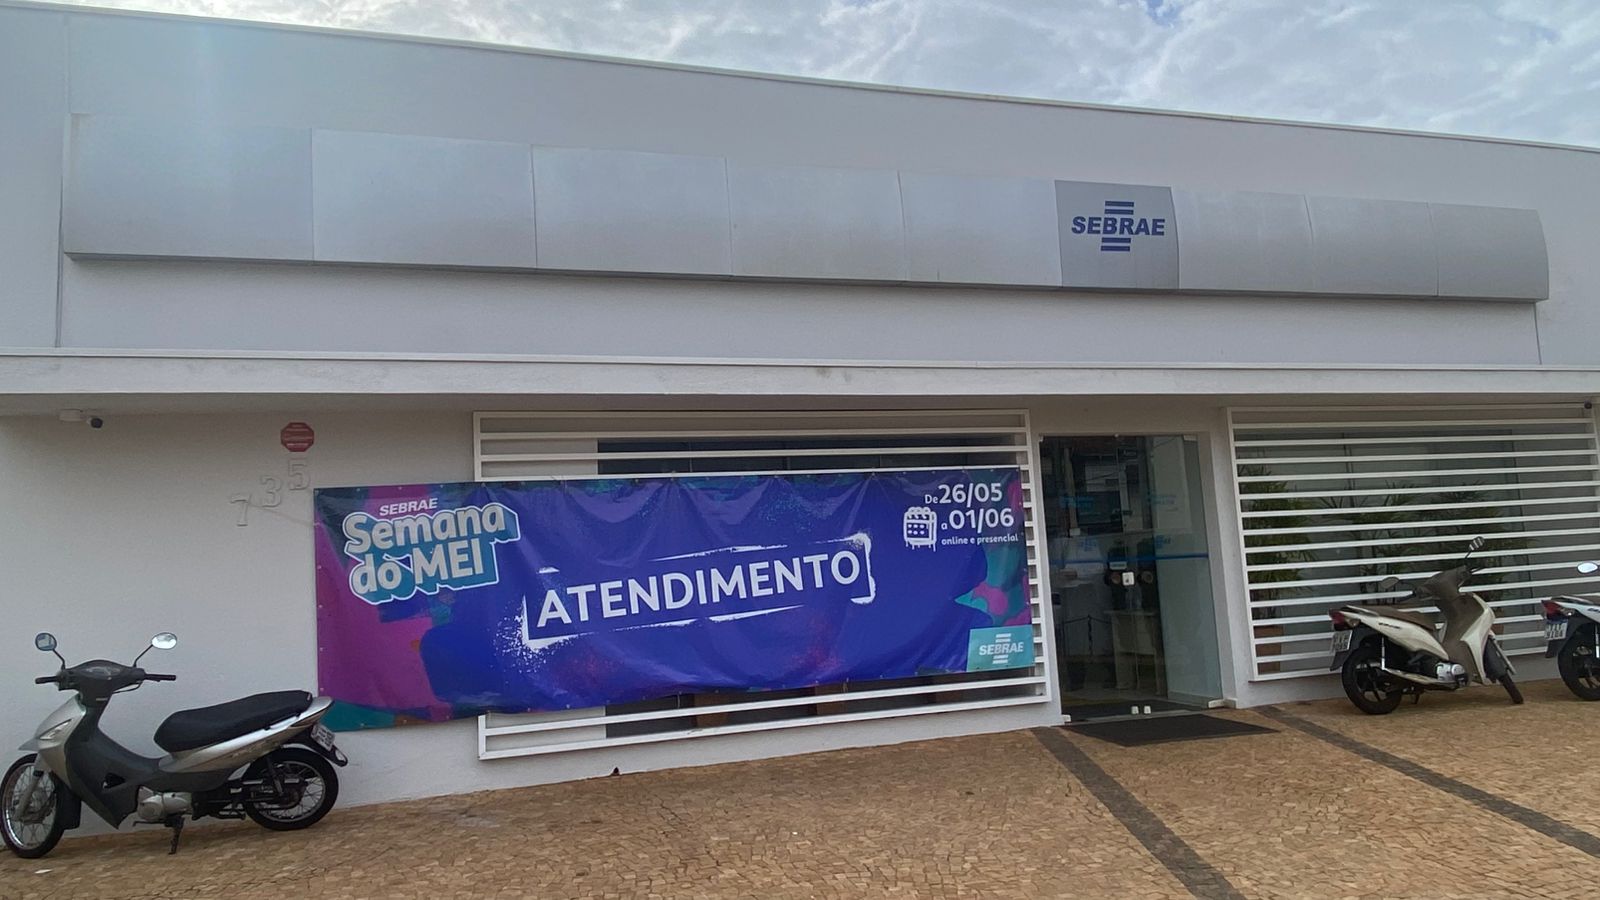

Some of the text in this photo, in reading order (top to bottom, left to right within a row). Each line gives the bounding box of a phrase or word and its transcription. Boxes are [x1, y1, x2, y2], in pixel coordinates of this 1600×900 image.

[1071, 216, 1166, 236] SEBRAE
[379, 498, 439, 516] SEBRAE
[924, 482, 1003, 508] De 26/05
[345, 505, 506, 554] Semana
[941, 508, 1014, 534] a 01/06
[941, 536, 968, 546] online
[976, 533, 1019, 546] presencial
[351, 538, 485, 595] do MEI
[536, 550, 860, 628] ATENDIMENTO
[978, 641, 1025, 656] SEBRAE
